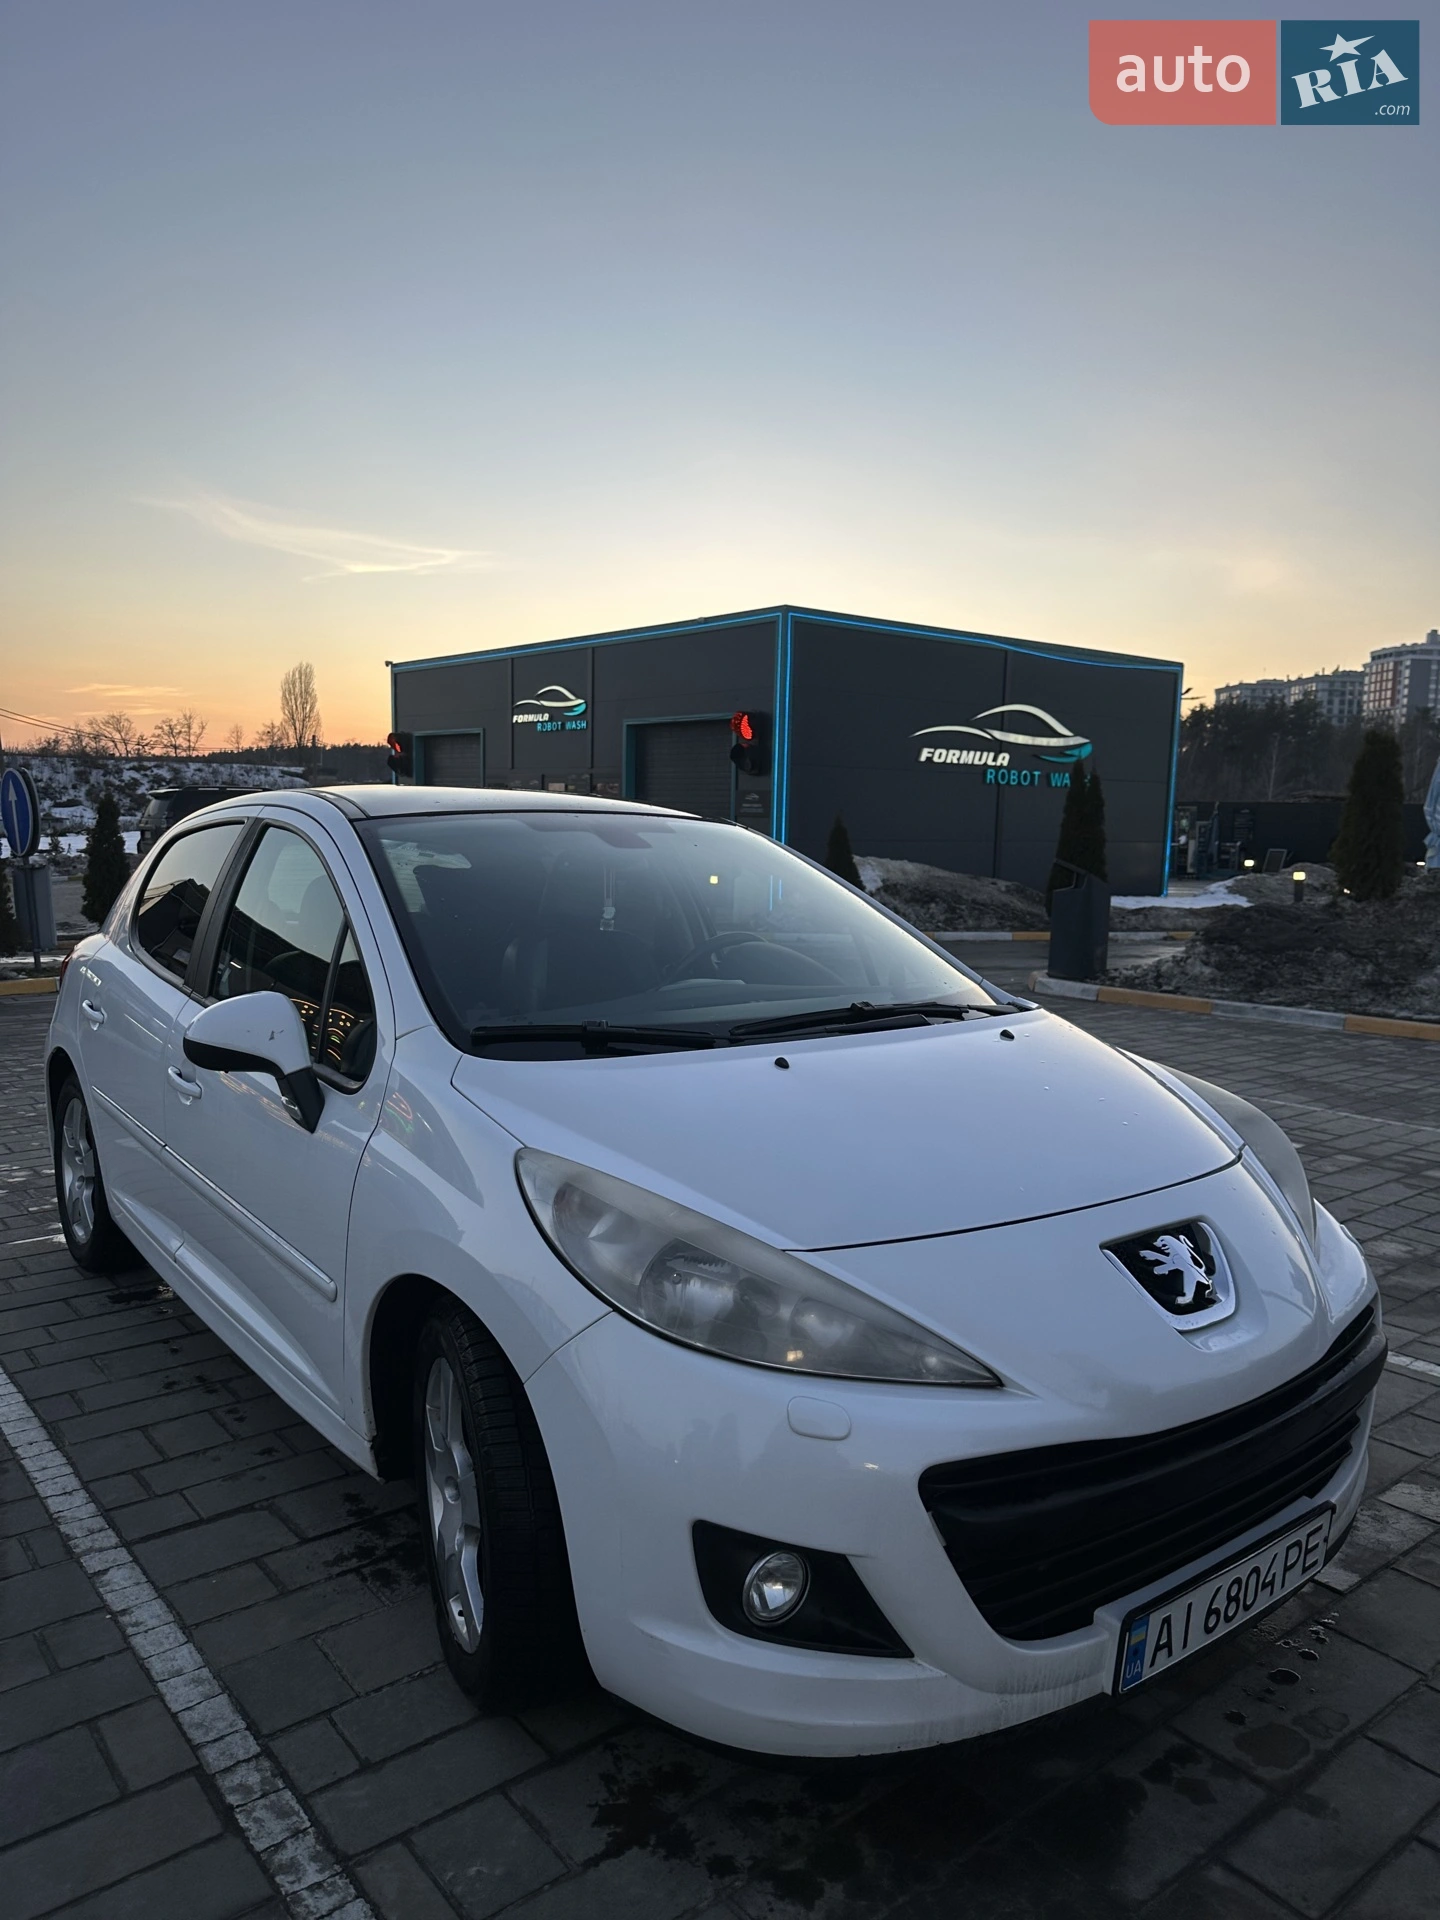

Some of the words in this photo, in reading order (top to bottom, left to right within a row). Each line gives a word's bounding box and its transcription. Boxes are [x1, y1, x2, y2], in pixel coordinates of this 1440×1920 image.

[512, 713, 549, 723] FORMULA
[537, 722, 562, 732] ROBOT
[565, 720, 586, 729] WASH
[919, 748, 1010, 766] FORMULA
[986, 768, 1042, 786] ROBOT
[1149, 1601, 1193, 1669] AI
[1126, 1659, 1142, 1679] UA
